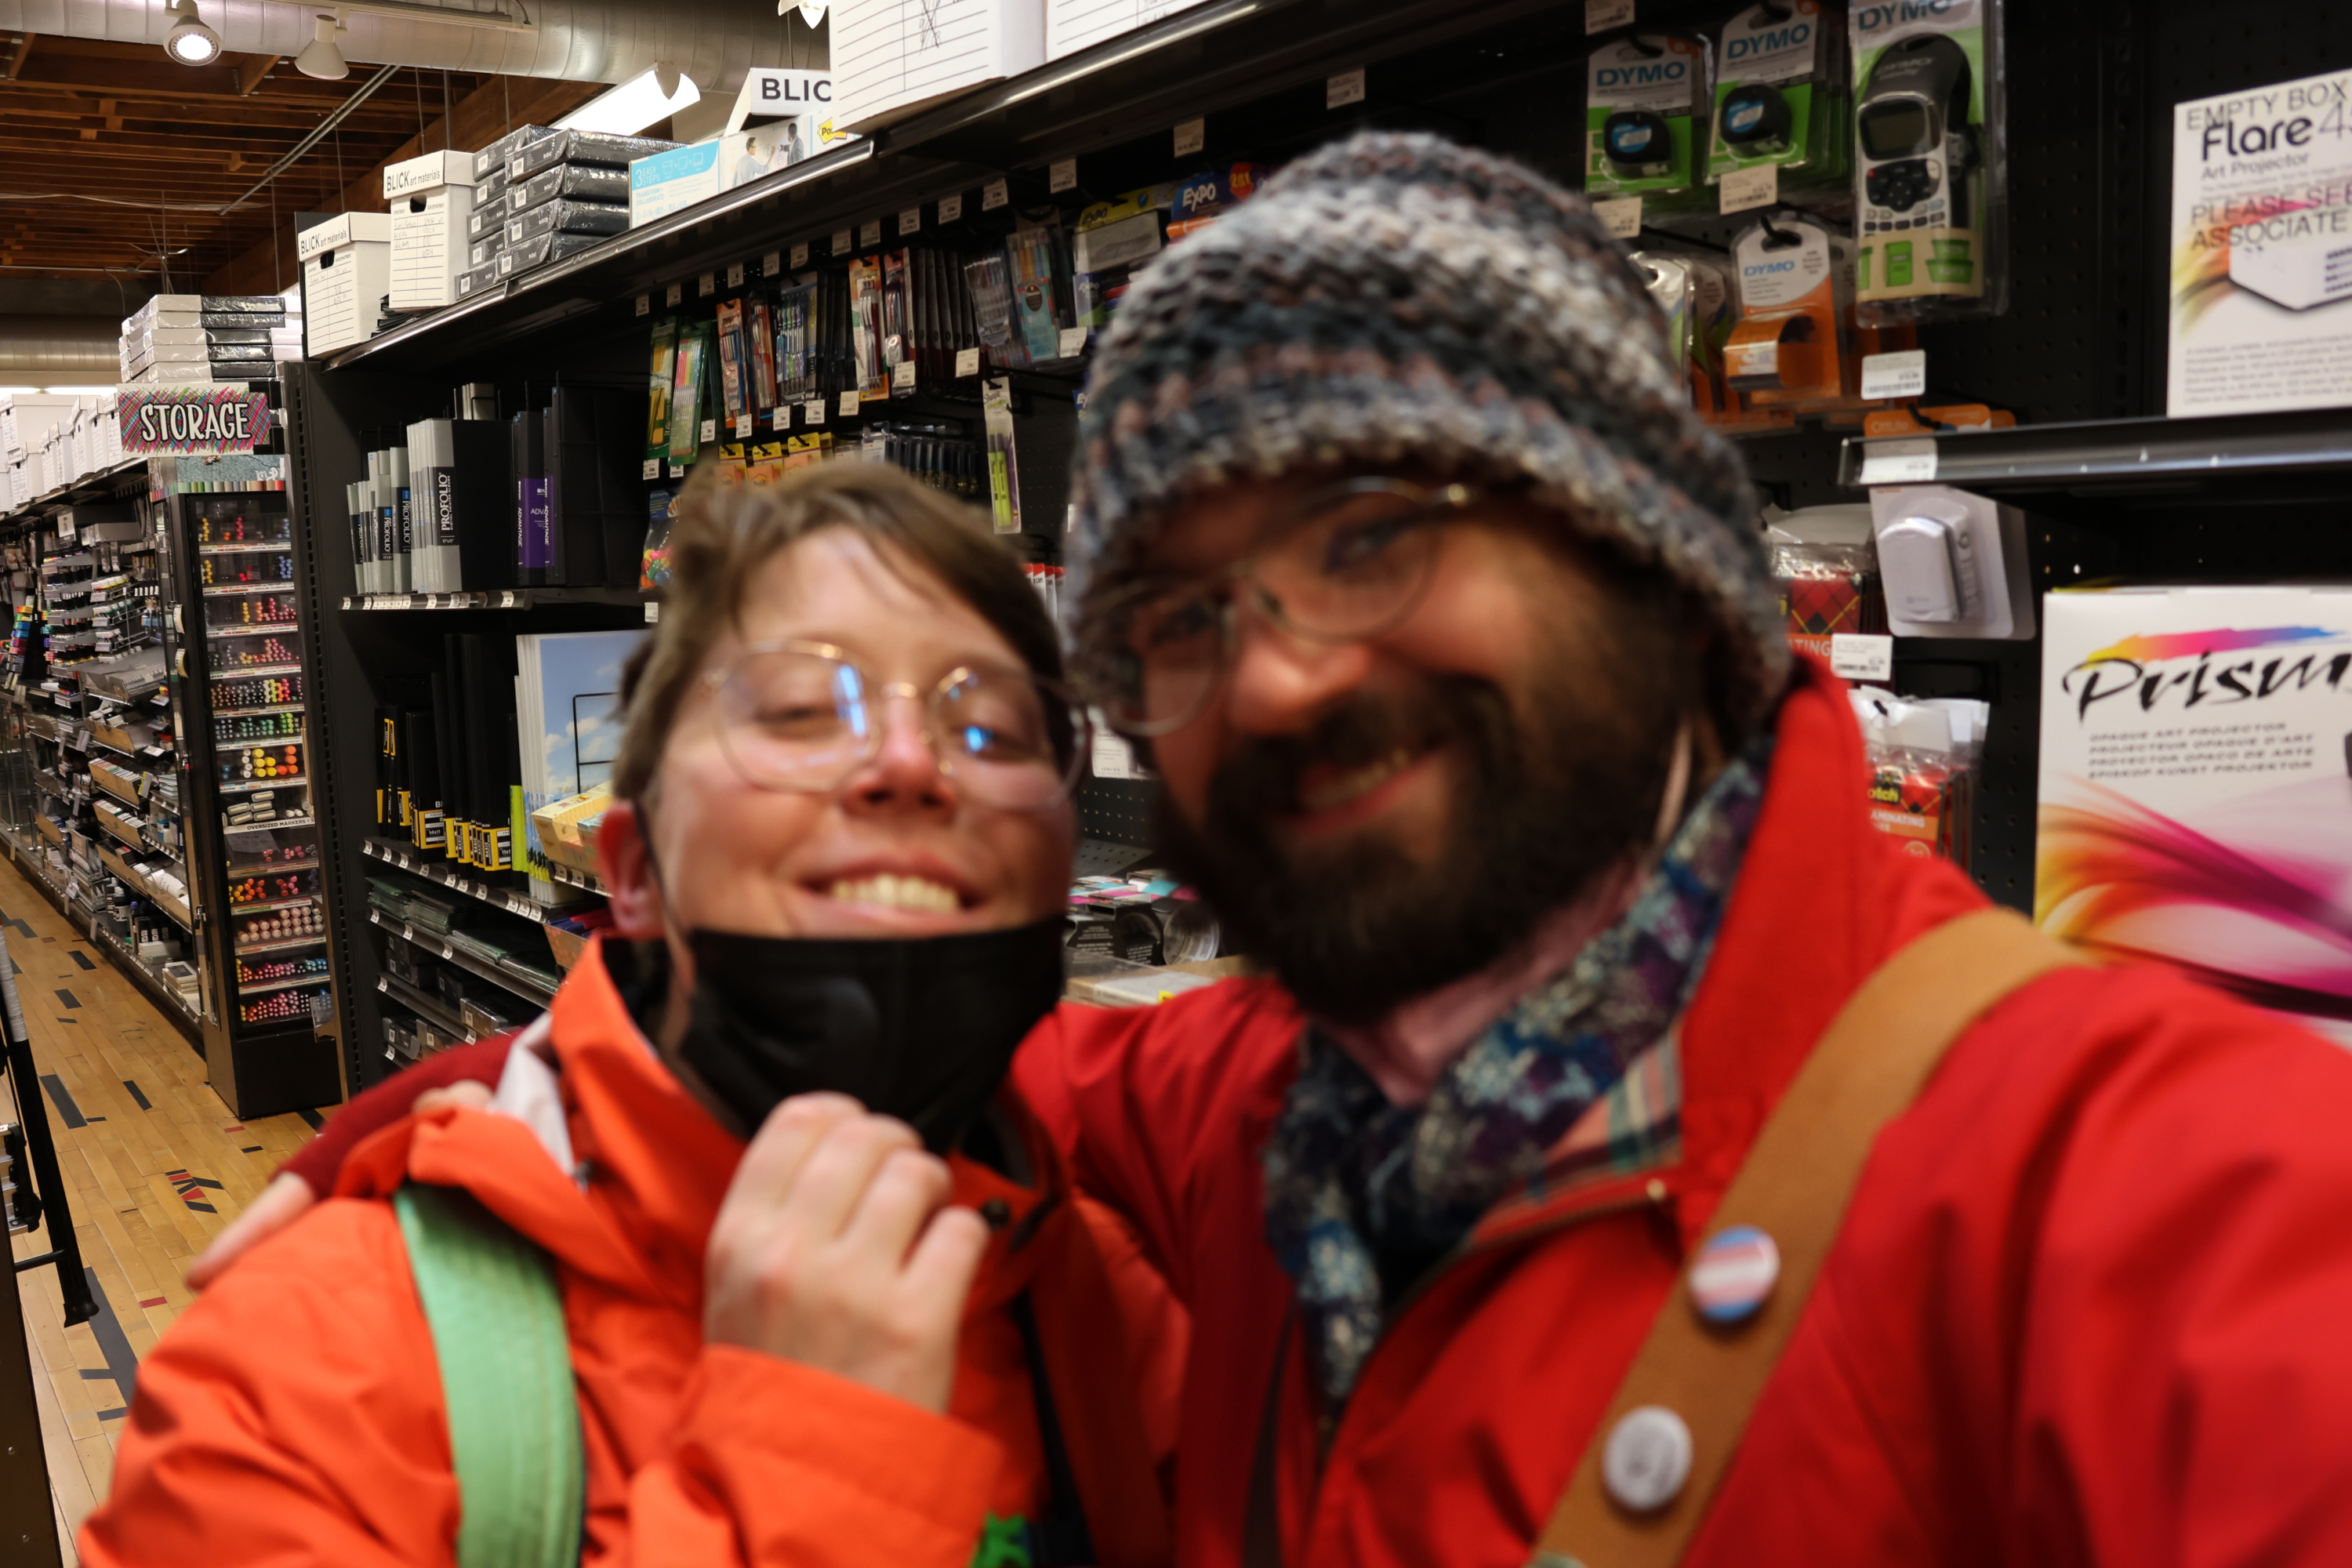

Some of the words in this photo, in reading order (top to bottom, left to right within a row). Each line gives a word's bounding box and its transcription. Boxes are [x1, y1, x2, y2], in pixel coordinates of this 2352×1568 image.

[1858, 0, 1952, 31] DYMO
[1726, 23, 1811, 60] DYMO
[1595, 61, 1686, 88] DYMO
[761, 78, 831, 103] BLIC
[2187, 93, 2279, 131] EMPTY
[2288, 78, 2348, 111] BOX
[2201, 114, 2312, 162] Flare
[636, 169, 643, 187] 3
[643, 165, 656, 177] EASY
[643, 174, 660, 186] STEPS
[2201, 165, 2225, 180] Art
[2230, 153, 2309, 175] Projector
[387, 170, 410, 192] BLICK
[418, 169, 440, 185] materials
[636, 188, 660, 198] TRANSFORM
[636, 194, 664, 206] COLLABORATE
[1182, 182, 1216, 212] EXPO
[2191, 194, 2286, 226] PLEASE
[300, 233, 321, 254] BLICK
[327, 230, 347, 244] materials
[2190, 209, 2348, 250] ASSOCIATE
[1744, 260, 1795, 277] DYMO
[140, 402, 252, 442] STORAGE
[438, 474, 451, 531] PROFOLIO
[402, 501, 411, 543] PROFOLIO
[2063, 649, 2352, 728] Prism
[2089, 731, 2148, 742] OPAQUE
[2156, 728, 2183, 739] ART
[2188, 721, 2286, 735] PROJECTOR
[2089, 741, 2188, 754] PROJECTEUR
[2193, 737, 2258, 749] OPAQUE
[2264, 733, 2313, 746] D'ART
[2089, 753, 2179, 767] PROYECTOR
[2184, 751, 2238, 762] OPACO
[2244, 750, 2265, 759] DE
[2273, 746, 2314, 757] ARTE
[2156, 765, 2207, 776] KUNST
[2212, 760, 2313, 772] PROJEKTOR
